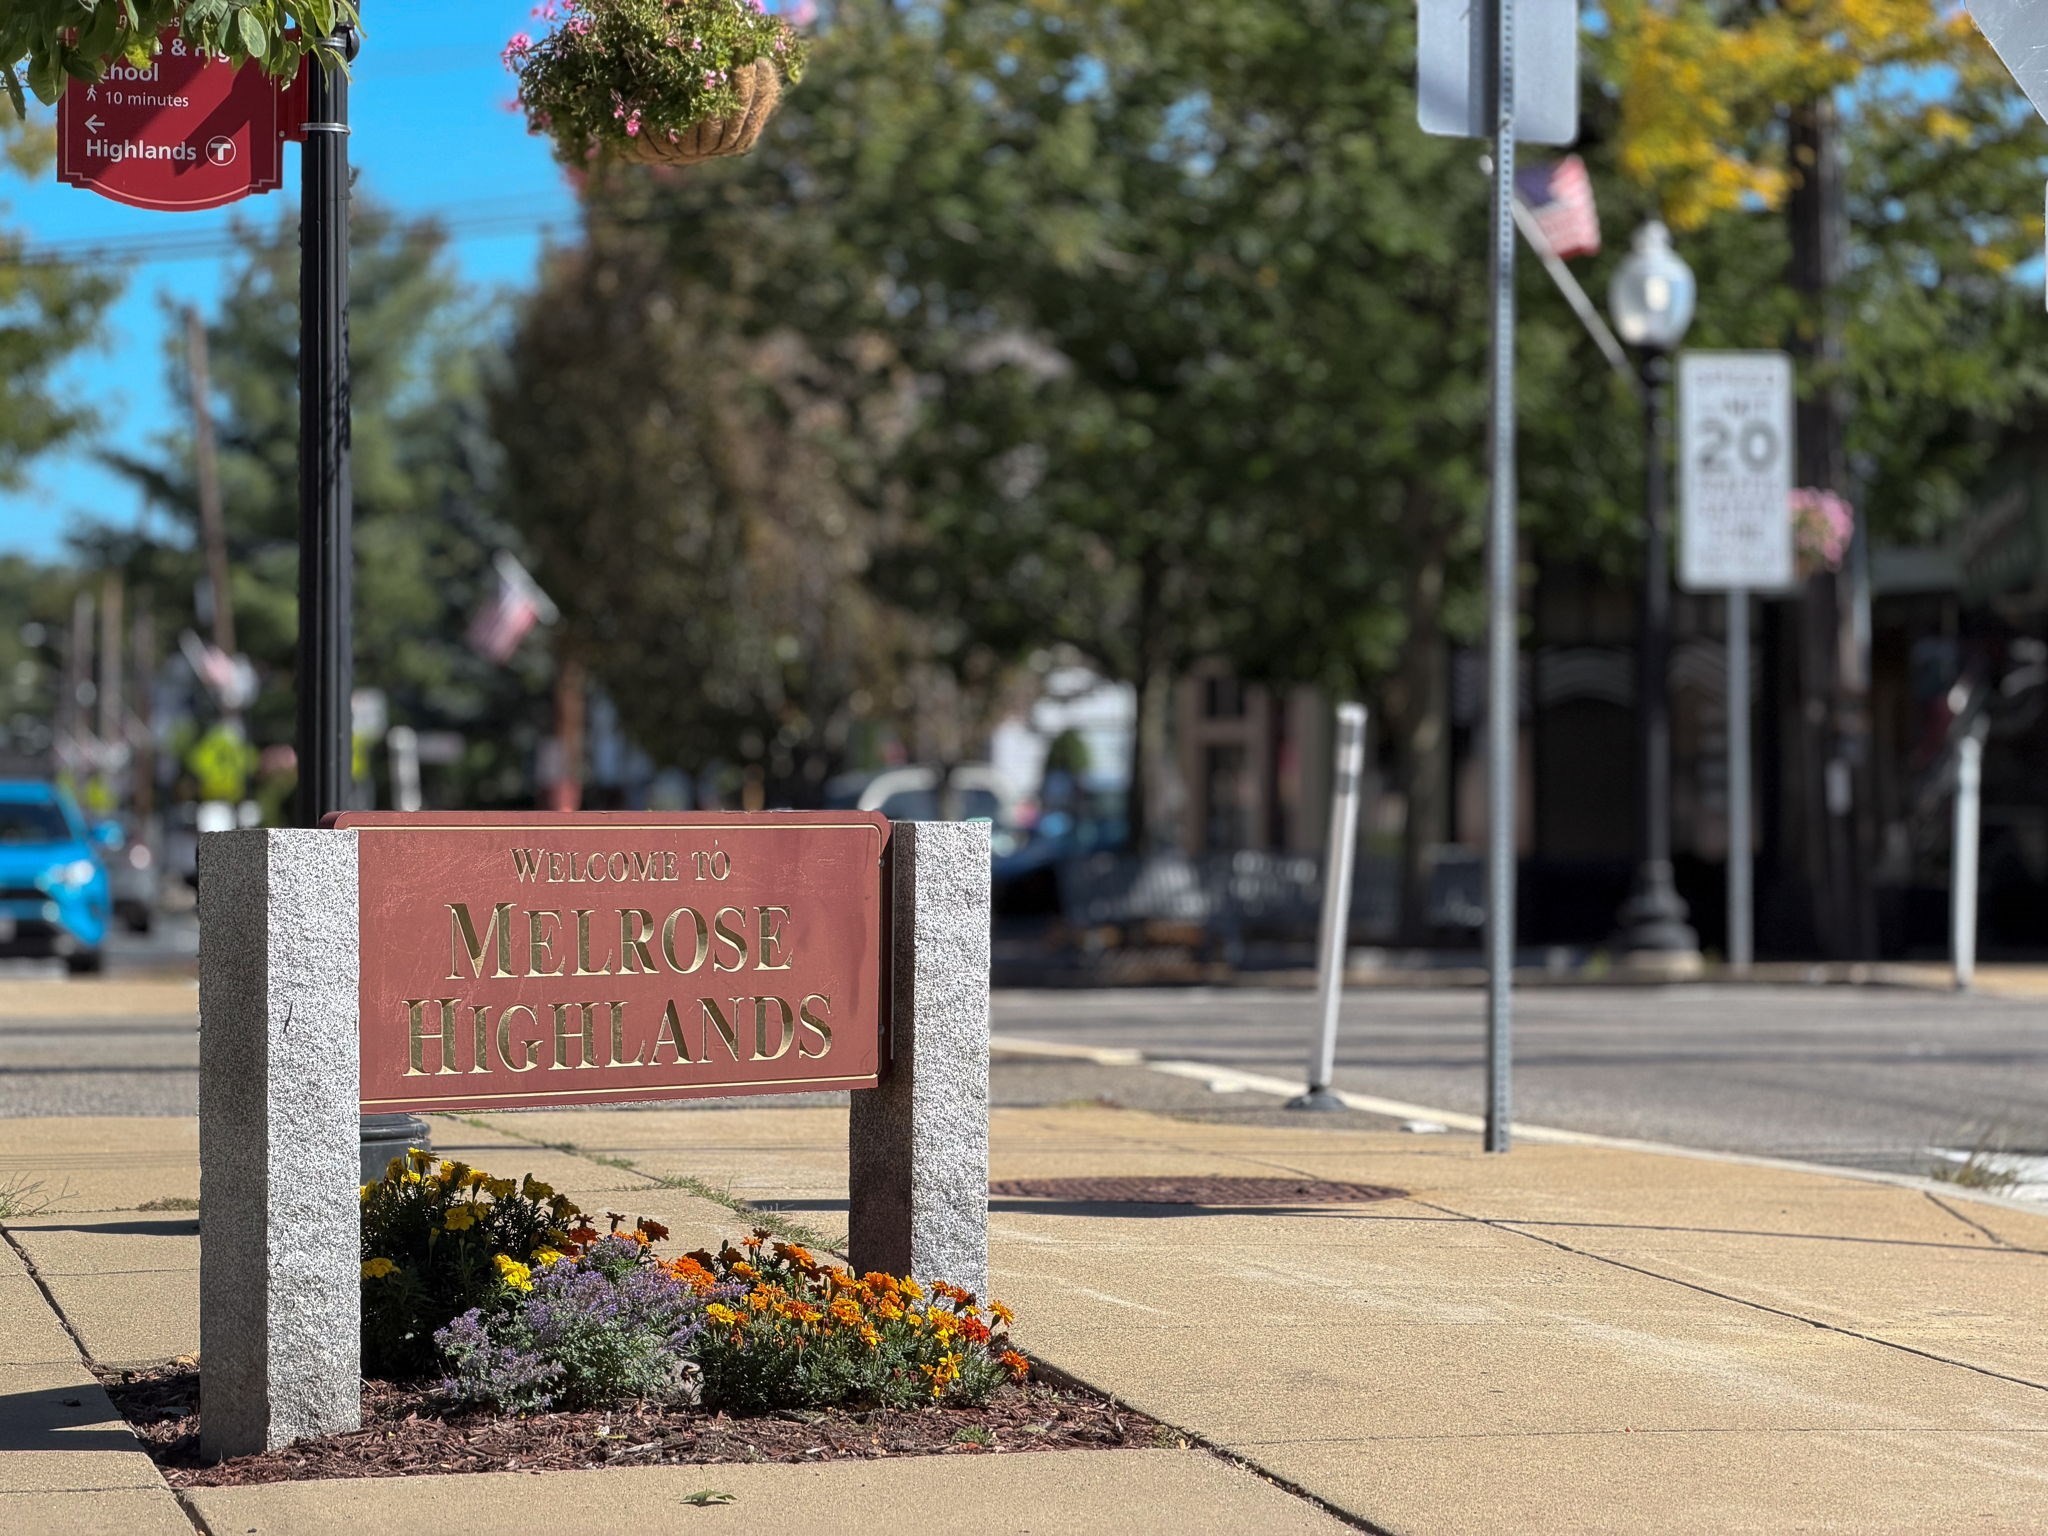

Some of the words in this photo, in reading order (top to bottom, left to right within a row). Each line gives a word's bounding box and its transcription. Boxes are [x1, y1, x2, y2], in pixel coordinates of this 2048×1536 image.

[171, 38, 187, 57] &
[105, 91, 123, 105] 10
[127, 91, 190, 108] minutes
[86, 138, 197, 163] Highlands
[1697, 418, 1779, 474] 20
[509, 848, 680, 883] WELCOME
[691, 850, 732, 881] TO
[444, 902, 793, 981] MELROSE
[401, 993, 833, 1077] HIGHLANDS
